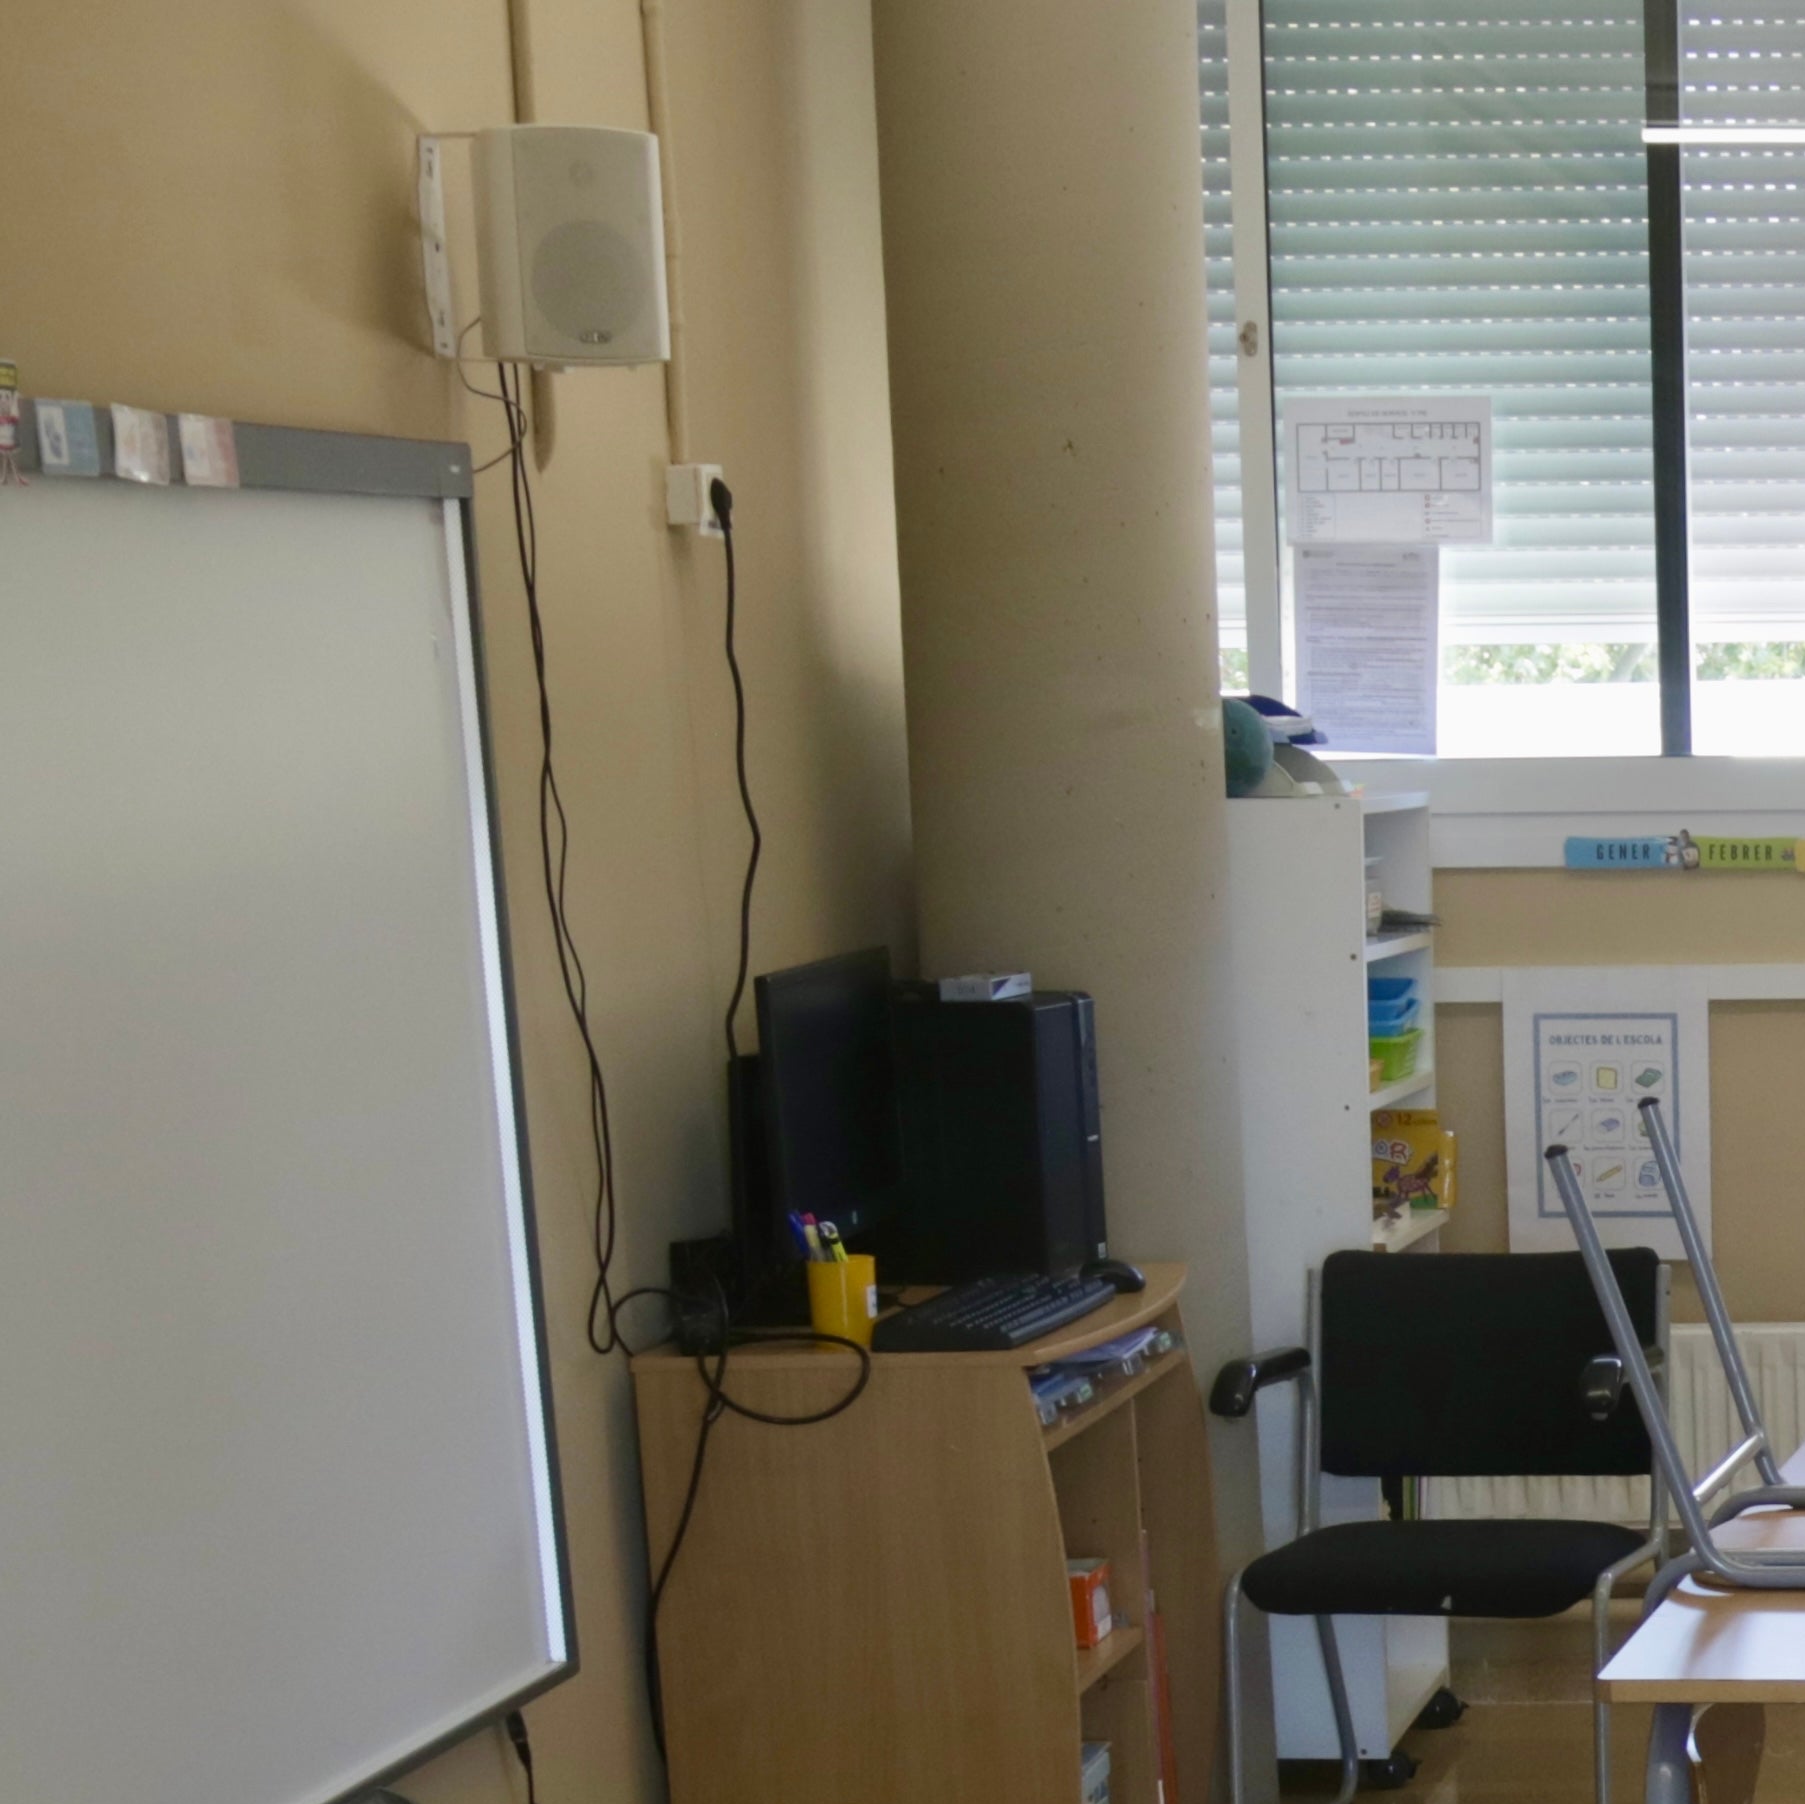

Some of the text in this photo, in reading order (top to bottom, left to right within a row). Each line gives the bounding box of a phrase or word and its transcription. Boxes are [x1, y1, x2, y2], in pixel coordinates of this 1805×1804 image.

[1595, 843, 1651, 861] GENER
[1708, 843, 1774, 862] FEBRER
[1549, 1034, 1598, 1045] OBJECTES
[1601, 1034, 1613, 1045] DE
